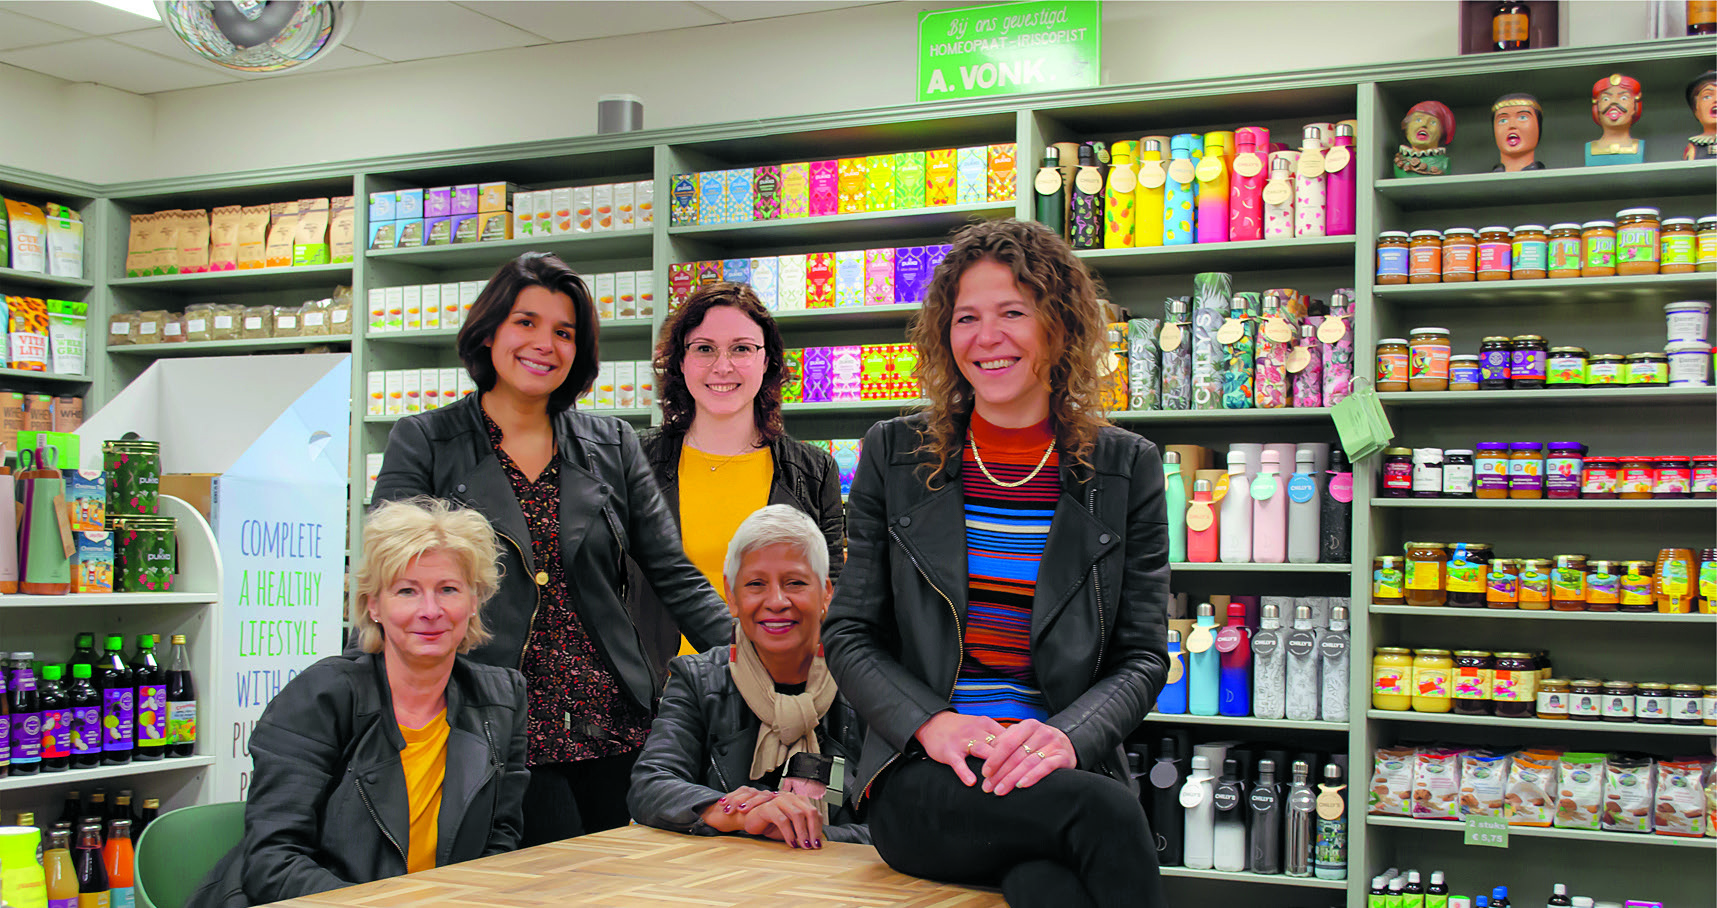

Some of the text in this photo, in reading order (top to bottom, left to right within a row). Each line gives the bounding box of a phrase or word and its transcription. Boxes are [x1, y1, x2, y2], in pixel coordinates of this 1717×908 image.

[947, 6, 1068, 39] Bij ons gevestigd
[927, 68, 955, 94] A.
[1131, 342, 1144, 408] CHILLY'S
[1194, 312, 1211, 404] CHILLY'S
[241, 519, 322, 559] COMPLETE
[238, 569, 322, 608] A HEALTHY
[239, 619, 318, 658] LIFESTYLE
[236, 668, 280, 709] WITH
[1469, 819, 1506, 830] 2 stuks
